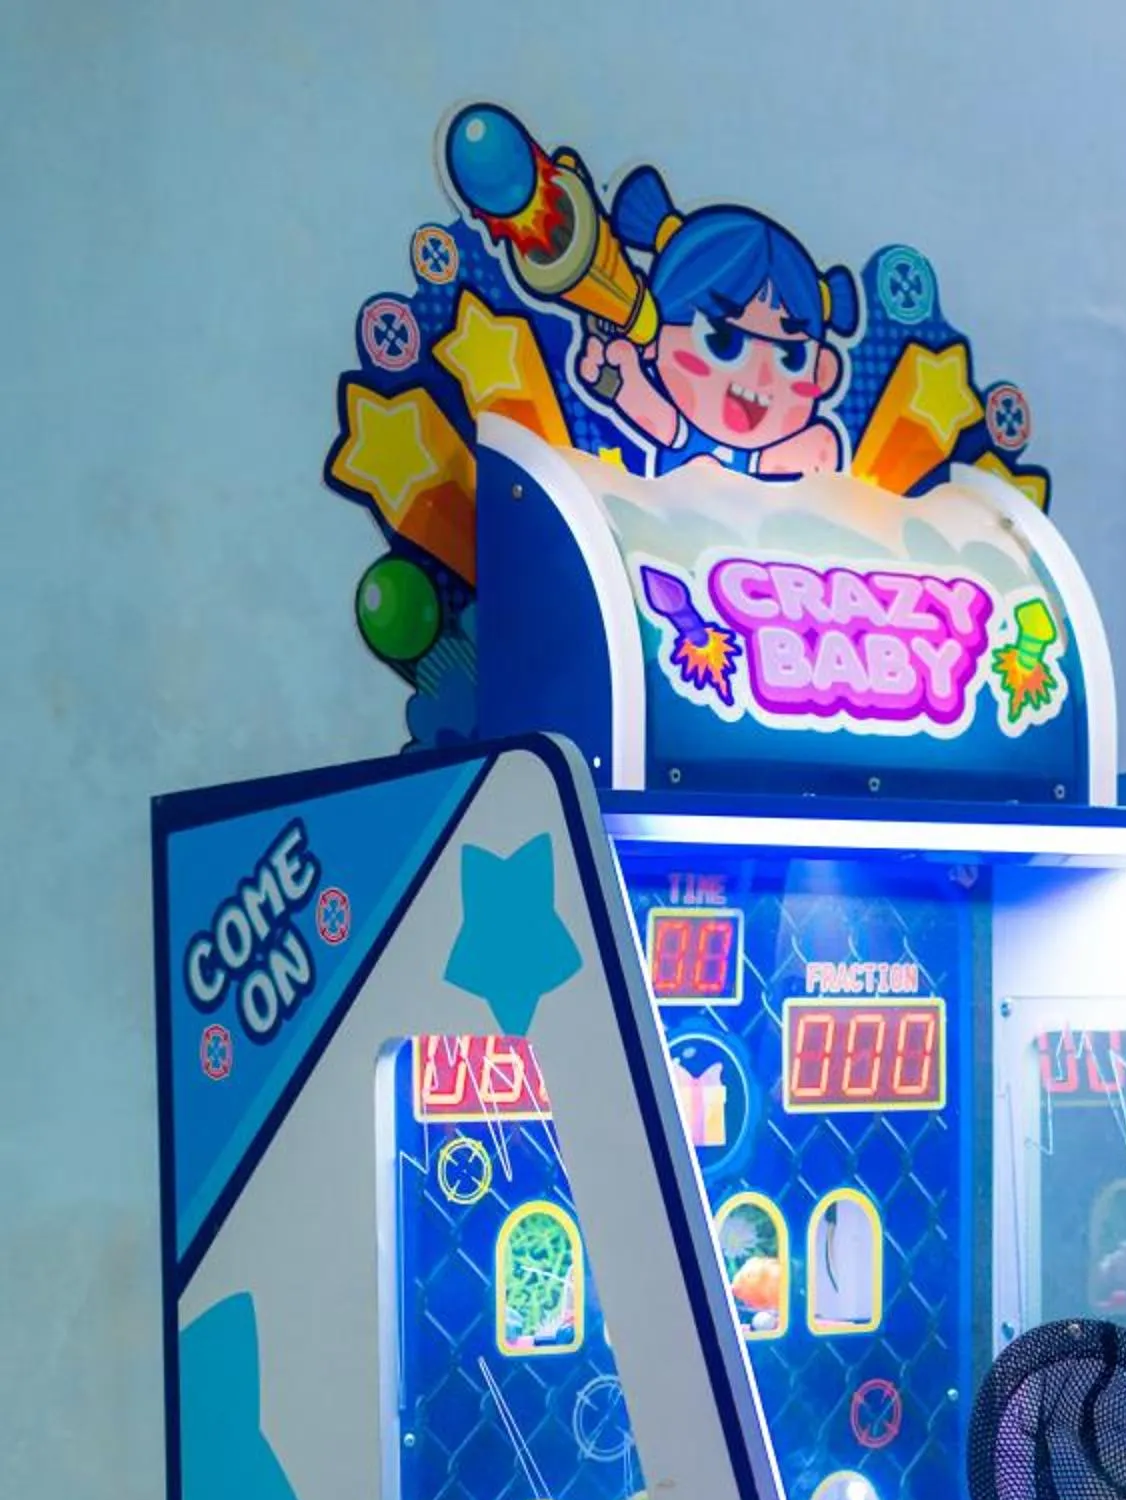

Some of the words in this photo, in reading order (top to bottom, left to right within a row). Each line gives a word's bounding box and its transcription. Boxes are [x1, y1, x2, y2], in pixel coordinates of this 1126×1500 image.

[716, 560, 979, 637] CRAZY
[755, 625, 964, 700] BABY
[187, 825, 315, 1003] COME
[668, 874, 728, 905] TIME
[240, 929, 312, 1034] ON
[805, 960, 919, 994] FRACTION
[789, 1011, 938, 1098] 000
